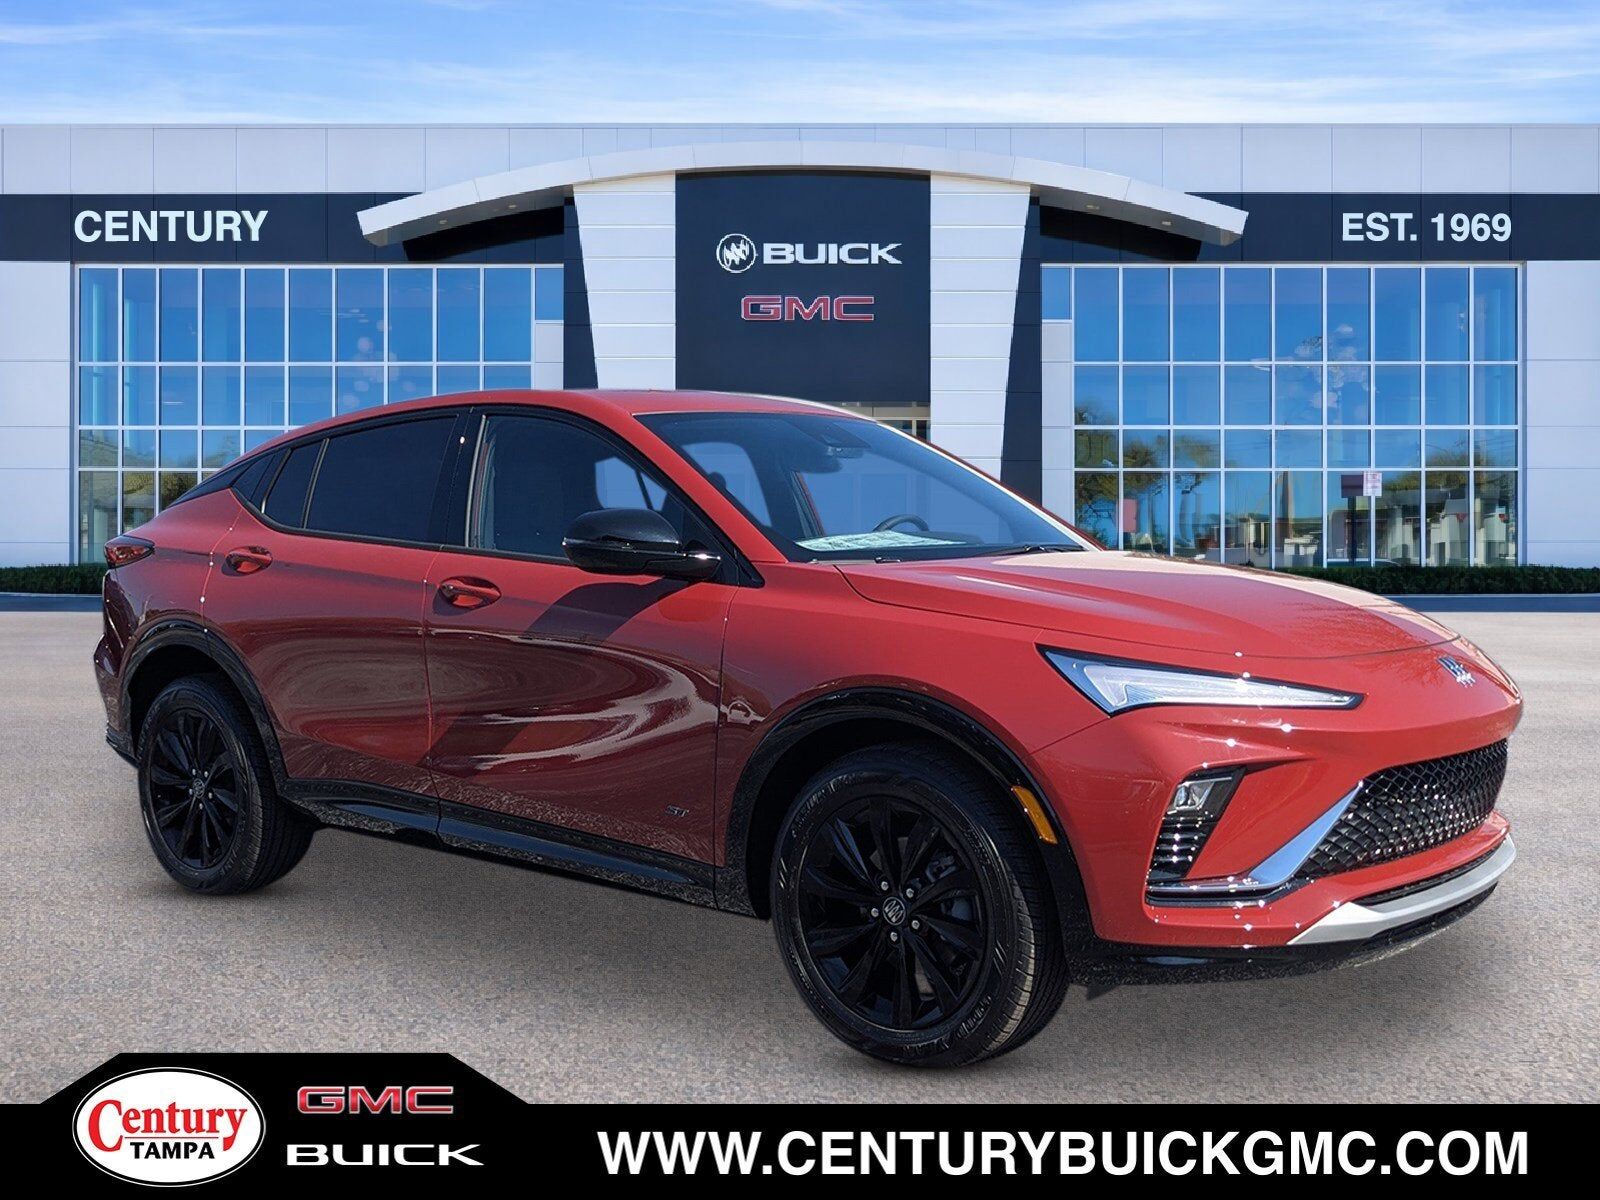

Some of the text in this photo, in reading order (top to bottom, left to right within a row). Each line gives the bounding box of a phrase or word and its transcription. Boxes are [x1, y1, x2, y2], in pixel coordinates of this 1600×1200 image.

[74, 210, 269, 243] CENTURY
[1342, 211, 1512, 242] EST. 1969
[762, 242, 903, 265] BUICK
[740, 294, 875, 322] GMC
